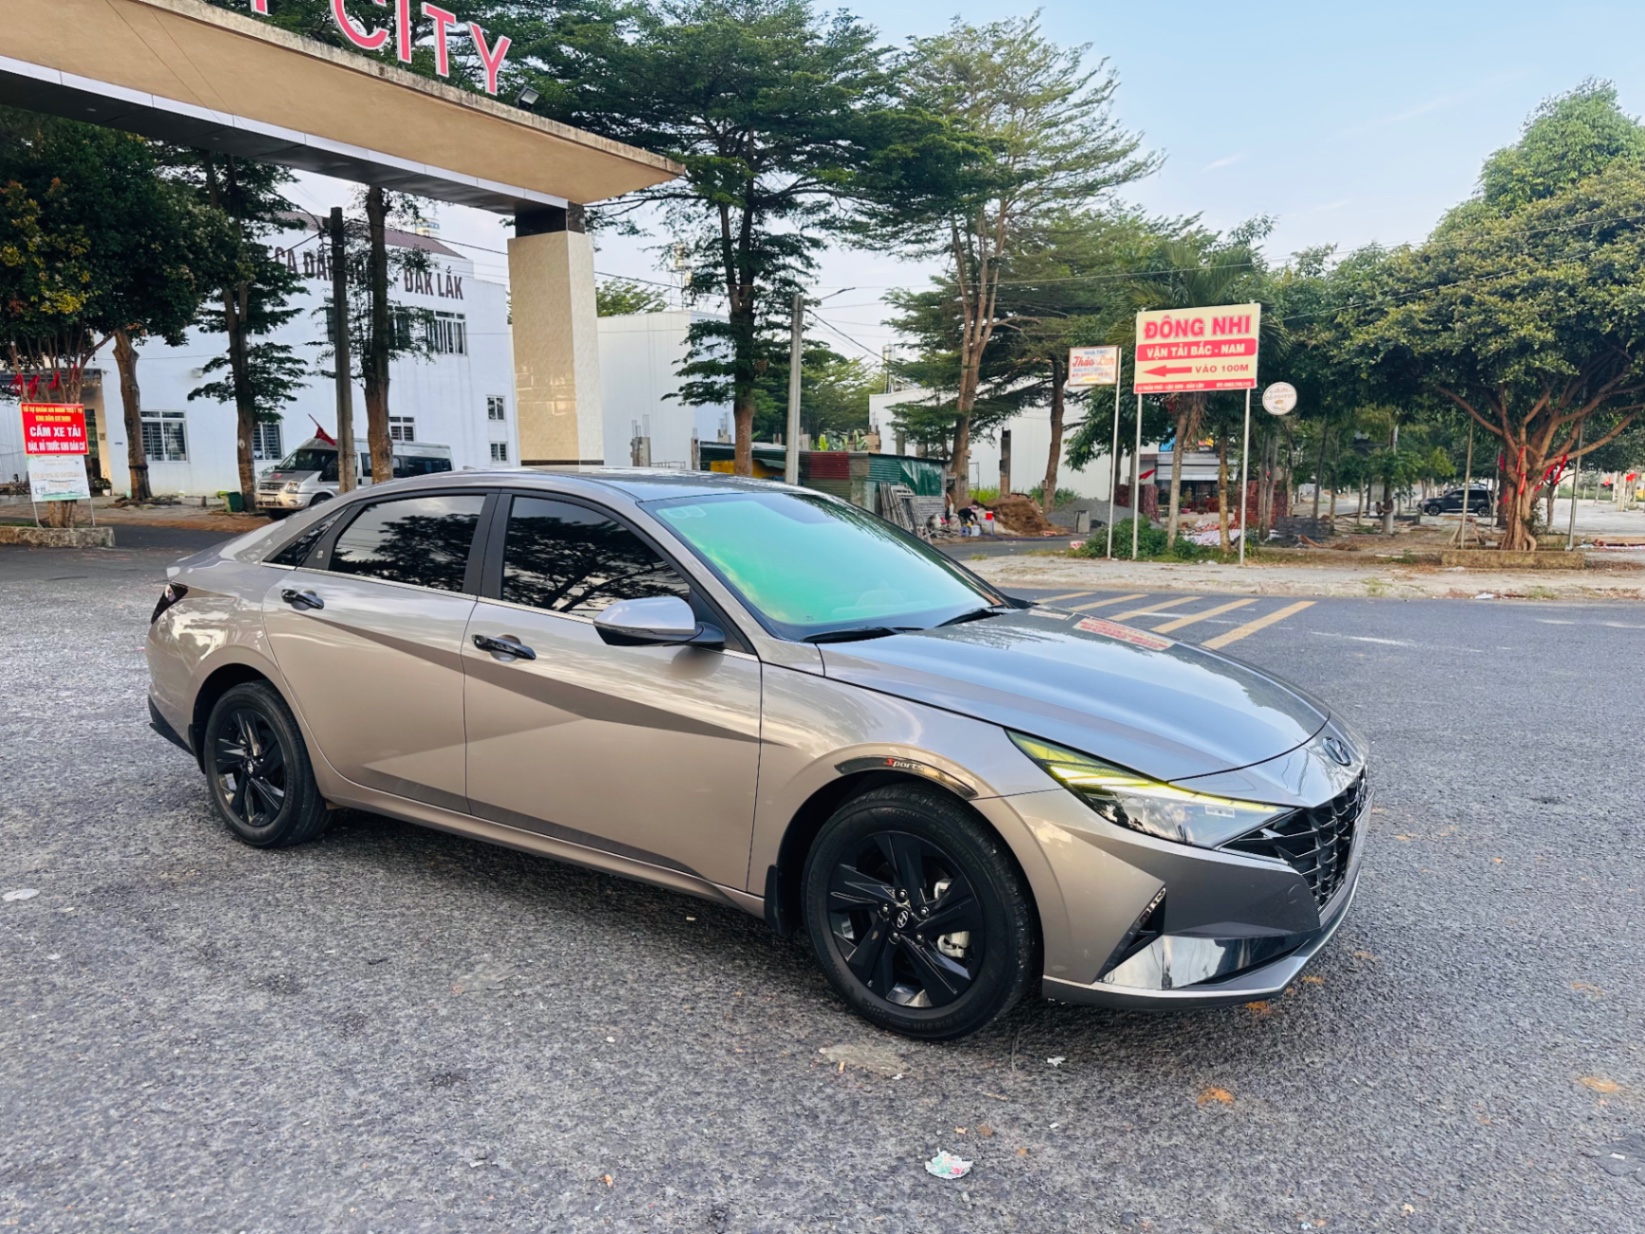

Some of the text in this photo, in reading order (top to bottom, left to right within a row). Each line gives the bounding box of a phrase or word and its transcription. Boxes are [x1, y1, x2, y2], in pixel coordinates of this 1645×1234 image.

[330, 0, 512, 95] CITY
[1143, 315, 1251, 340] ĐÔNG NHI
[1146, 347, 1168, 360] VẬN
[1170, 343, 1188, 357] TẢI
[1190, 341, 1212, 356] BẮC
[1221, 343, 1245, 355] NAM
[1195, 363, 1249, 374] VÀO 100M
[29, 423, 82, 437] CẤM XE TẢI
